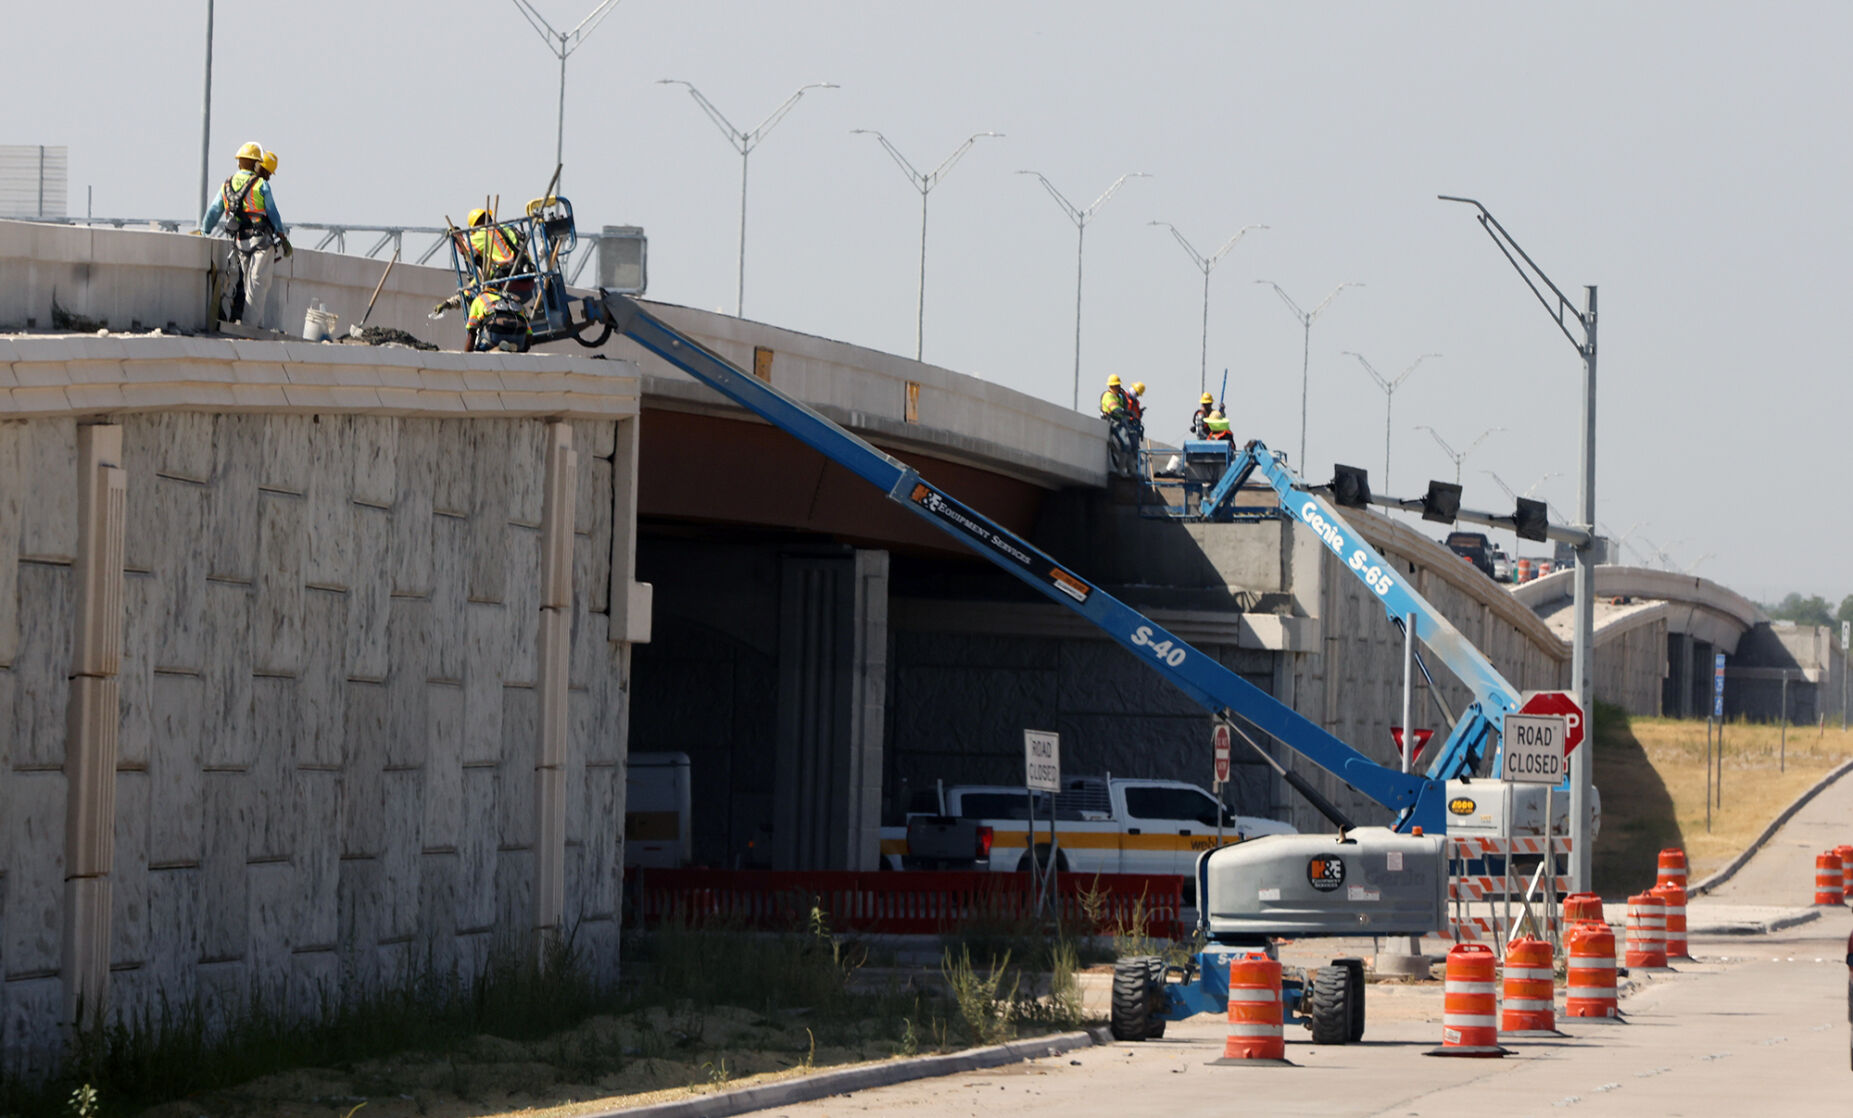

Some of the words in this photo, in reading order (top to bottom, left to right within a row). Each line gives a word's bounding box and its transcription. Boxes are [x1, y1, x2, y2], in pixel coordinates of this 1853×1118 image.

[938, 502, 991, 539] EQUIPMENT
[990, 535, 1032, 565] SERVICES
[1301, 501, 1344, 553] Genie
[1348, 549, 1394, 596] S-65
[1130, 625, 1187, 667] S-40
[1517, 725, 1553, 746] ROAD
[1032, 739, 1052, 758] ROAD
[1029, 762, 1057, 783] CLOSED
[1508, 752, 1559, 774] CLOSED
